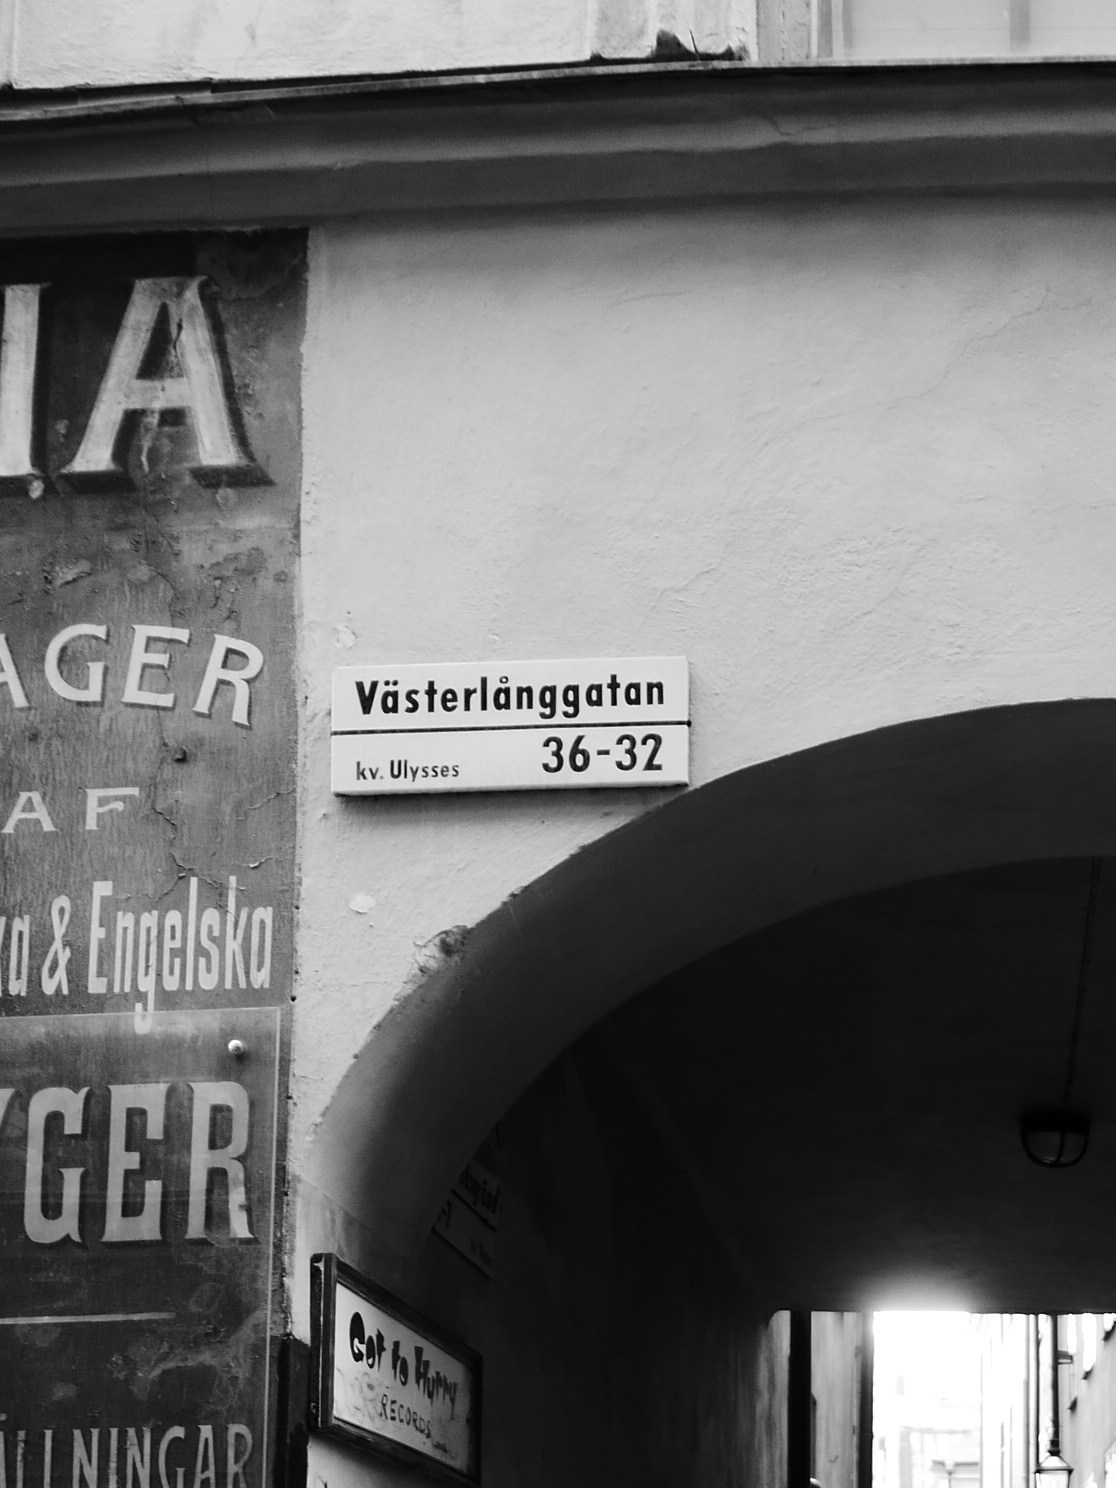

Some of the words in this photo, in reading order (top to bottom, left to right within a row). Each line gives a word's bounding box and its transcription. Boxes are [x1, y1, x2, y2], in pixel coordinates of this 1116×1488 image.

[355, 674, 665, 720] Västerlånggatan
[356, 760, 384, 781] kv.
[390, 759, 460, 782] Ulysses
[541, 733, 663, 774] 36-32
[41, 894, 72, 995] &
[88, 876, 273, 1034] Engelska
[0, 1081, 256, 1244] GER
[380, 1393, 432, 1440] RECORDS
